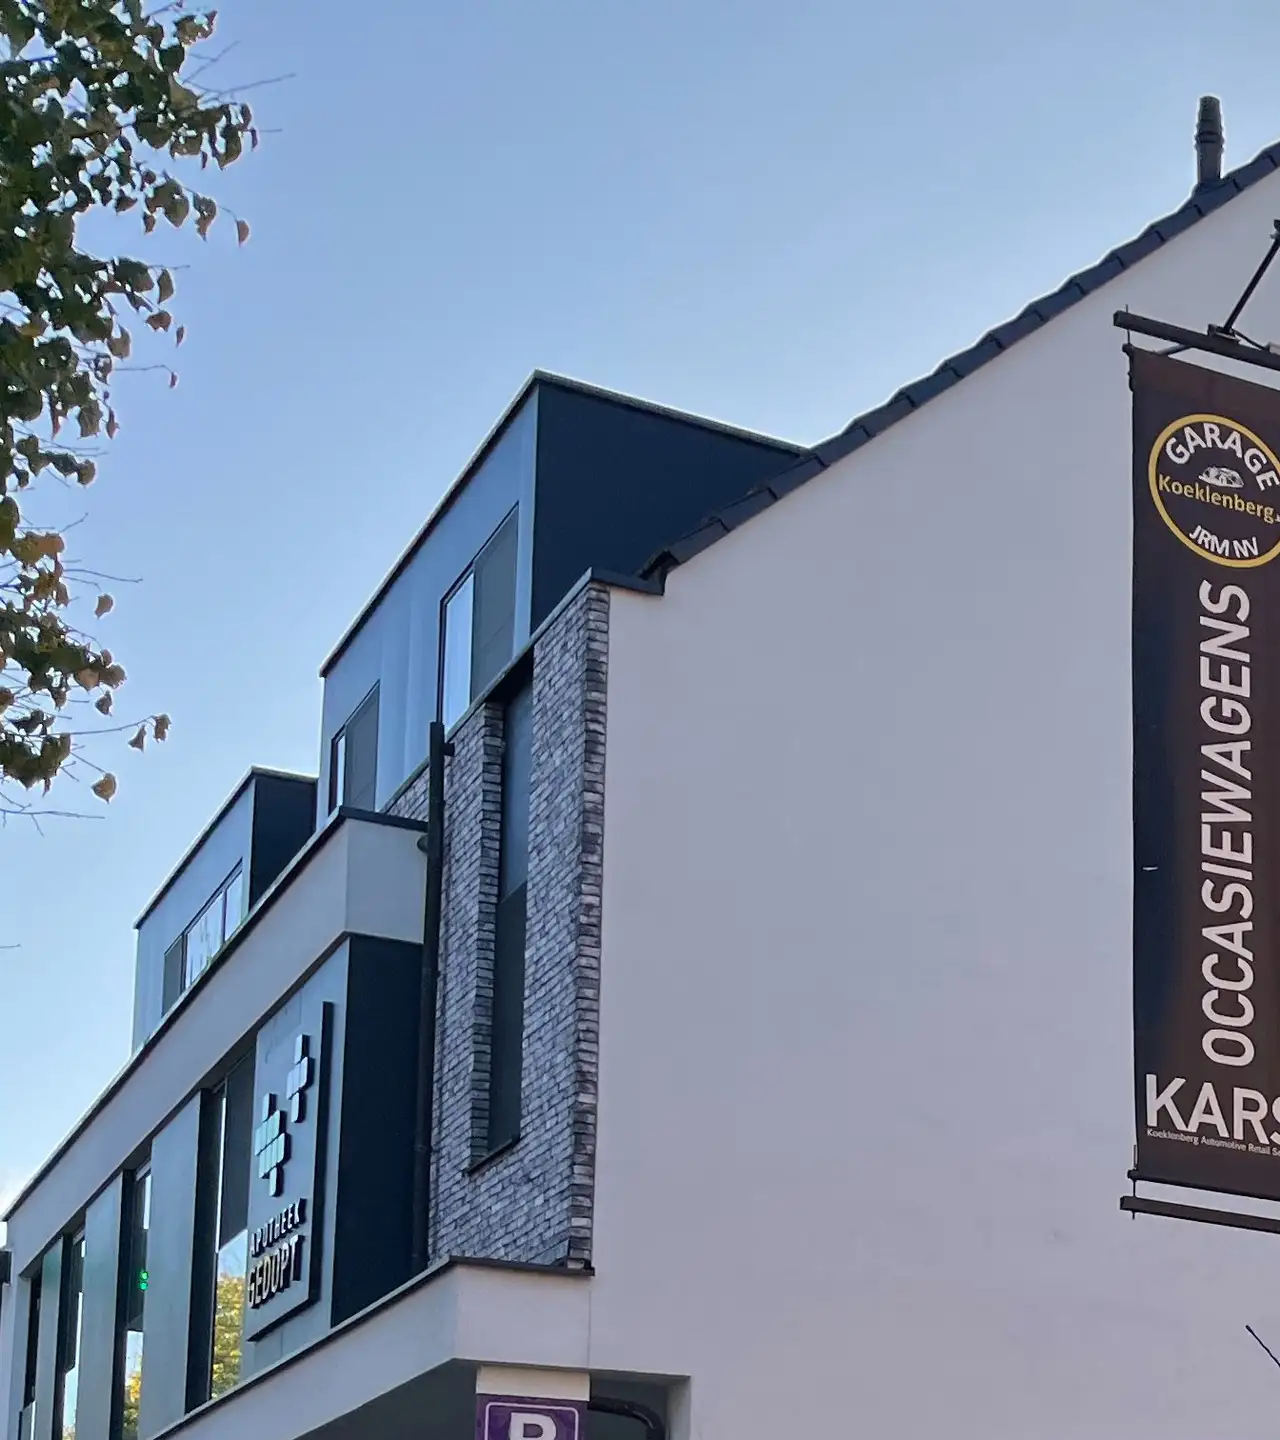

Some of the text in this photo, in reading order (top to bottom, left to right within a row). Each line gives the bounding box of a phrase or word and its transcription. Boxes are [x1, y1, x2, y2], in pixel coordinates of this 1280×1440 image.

[1166, 422, 1280, 491] GARAGE
[1189, 525, 1259, 558] JRM NV
[1198, 580, 1256, 1067] OCCASIEWAGENS
[1201, 1135, 1247, 1152] Automotive
[249, 1198, 302, 1258] APOTHEEK
